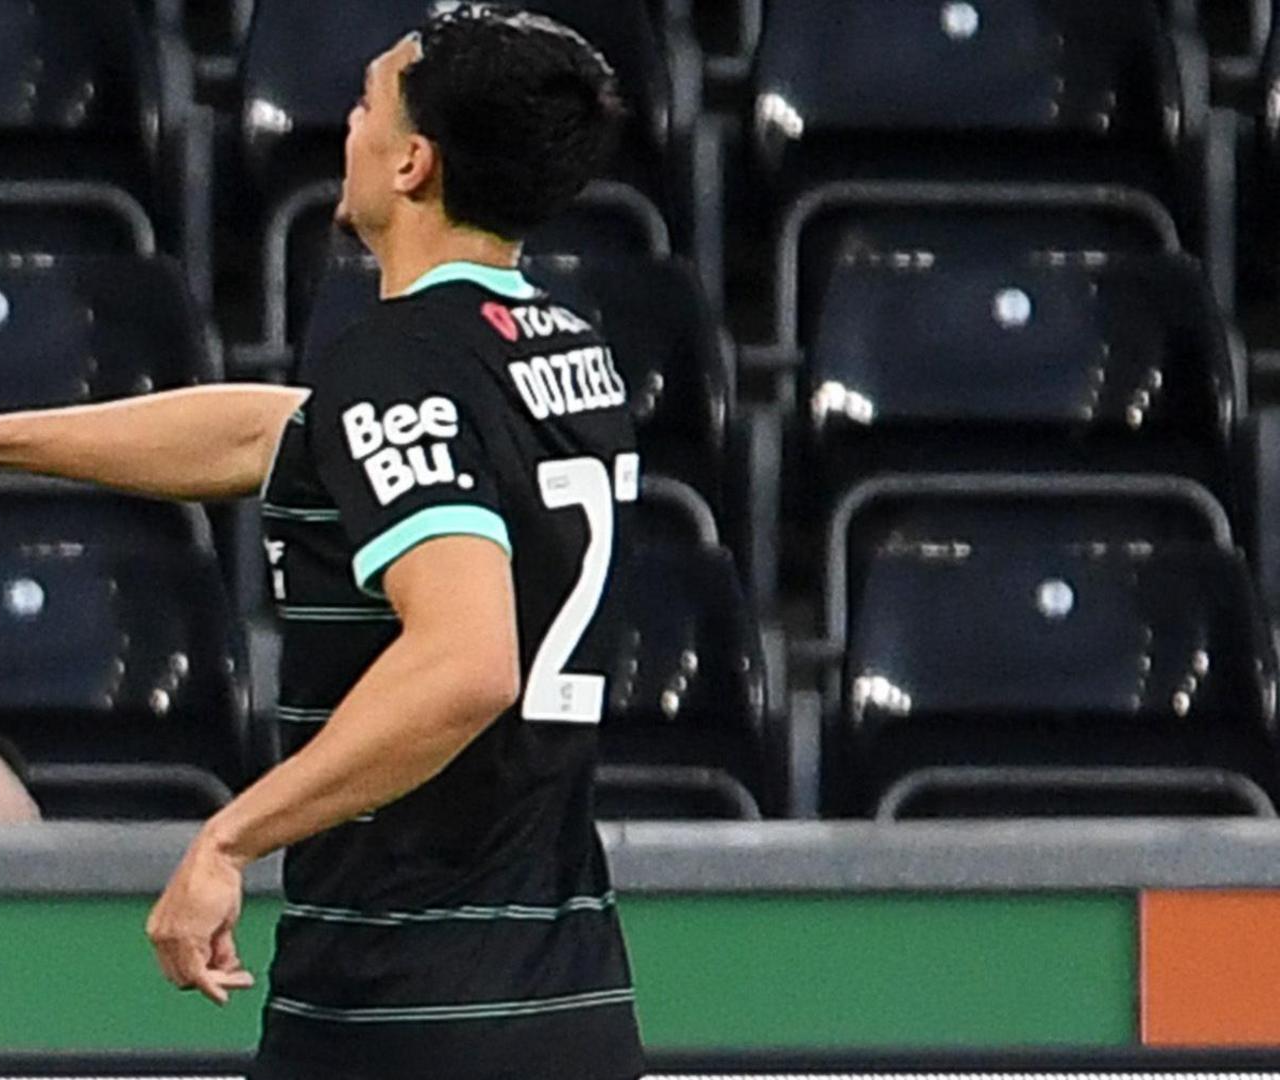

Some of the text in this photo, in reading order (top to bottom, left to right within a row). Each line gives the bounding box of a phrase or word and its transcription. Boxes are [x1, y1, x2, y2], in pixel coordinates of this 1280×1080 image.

[341, 396, 459, 461] Bee
[363, 442, 474, 506] Bu.
[520, 452, 640, 724] 2
